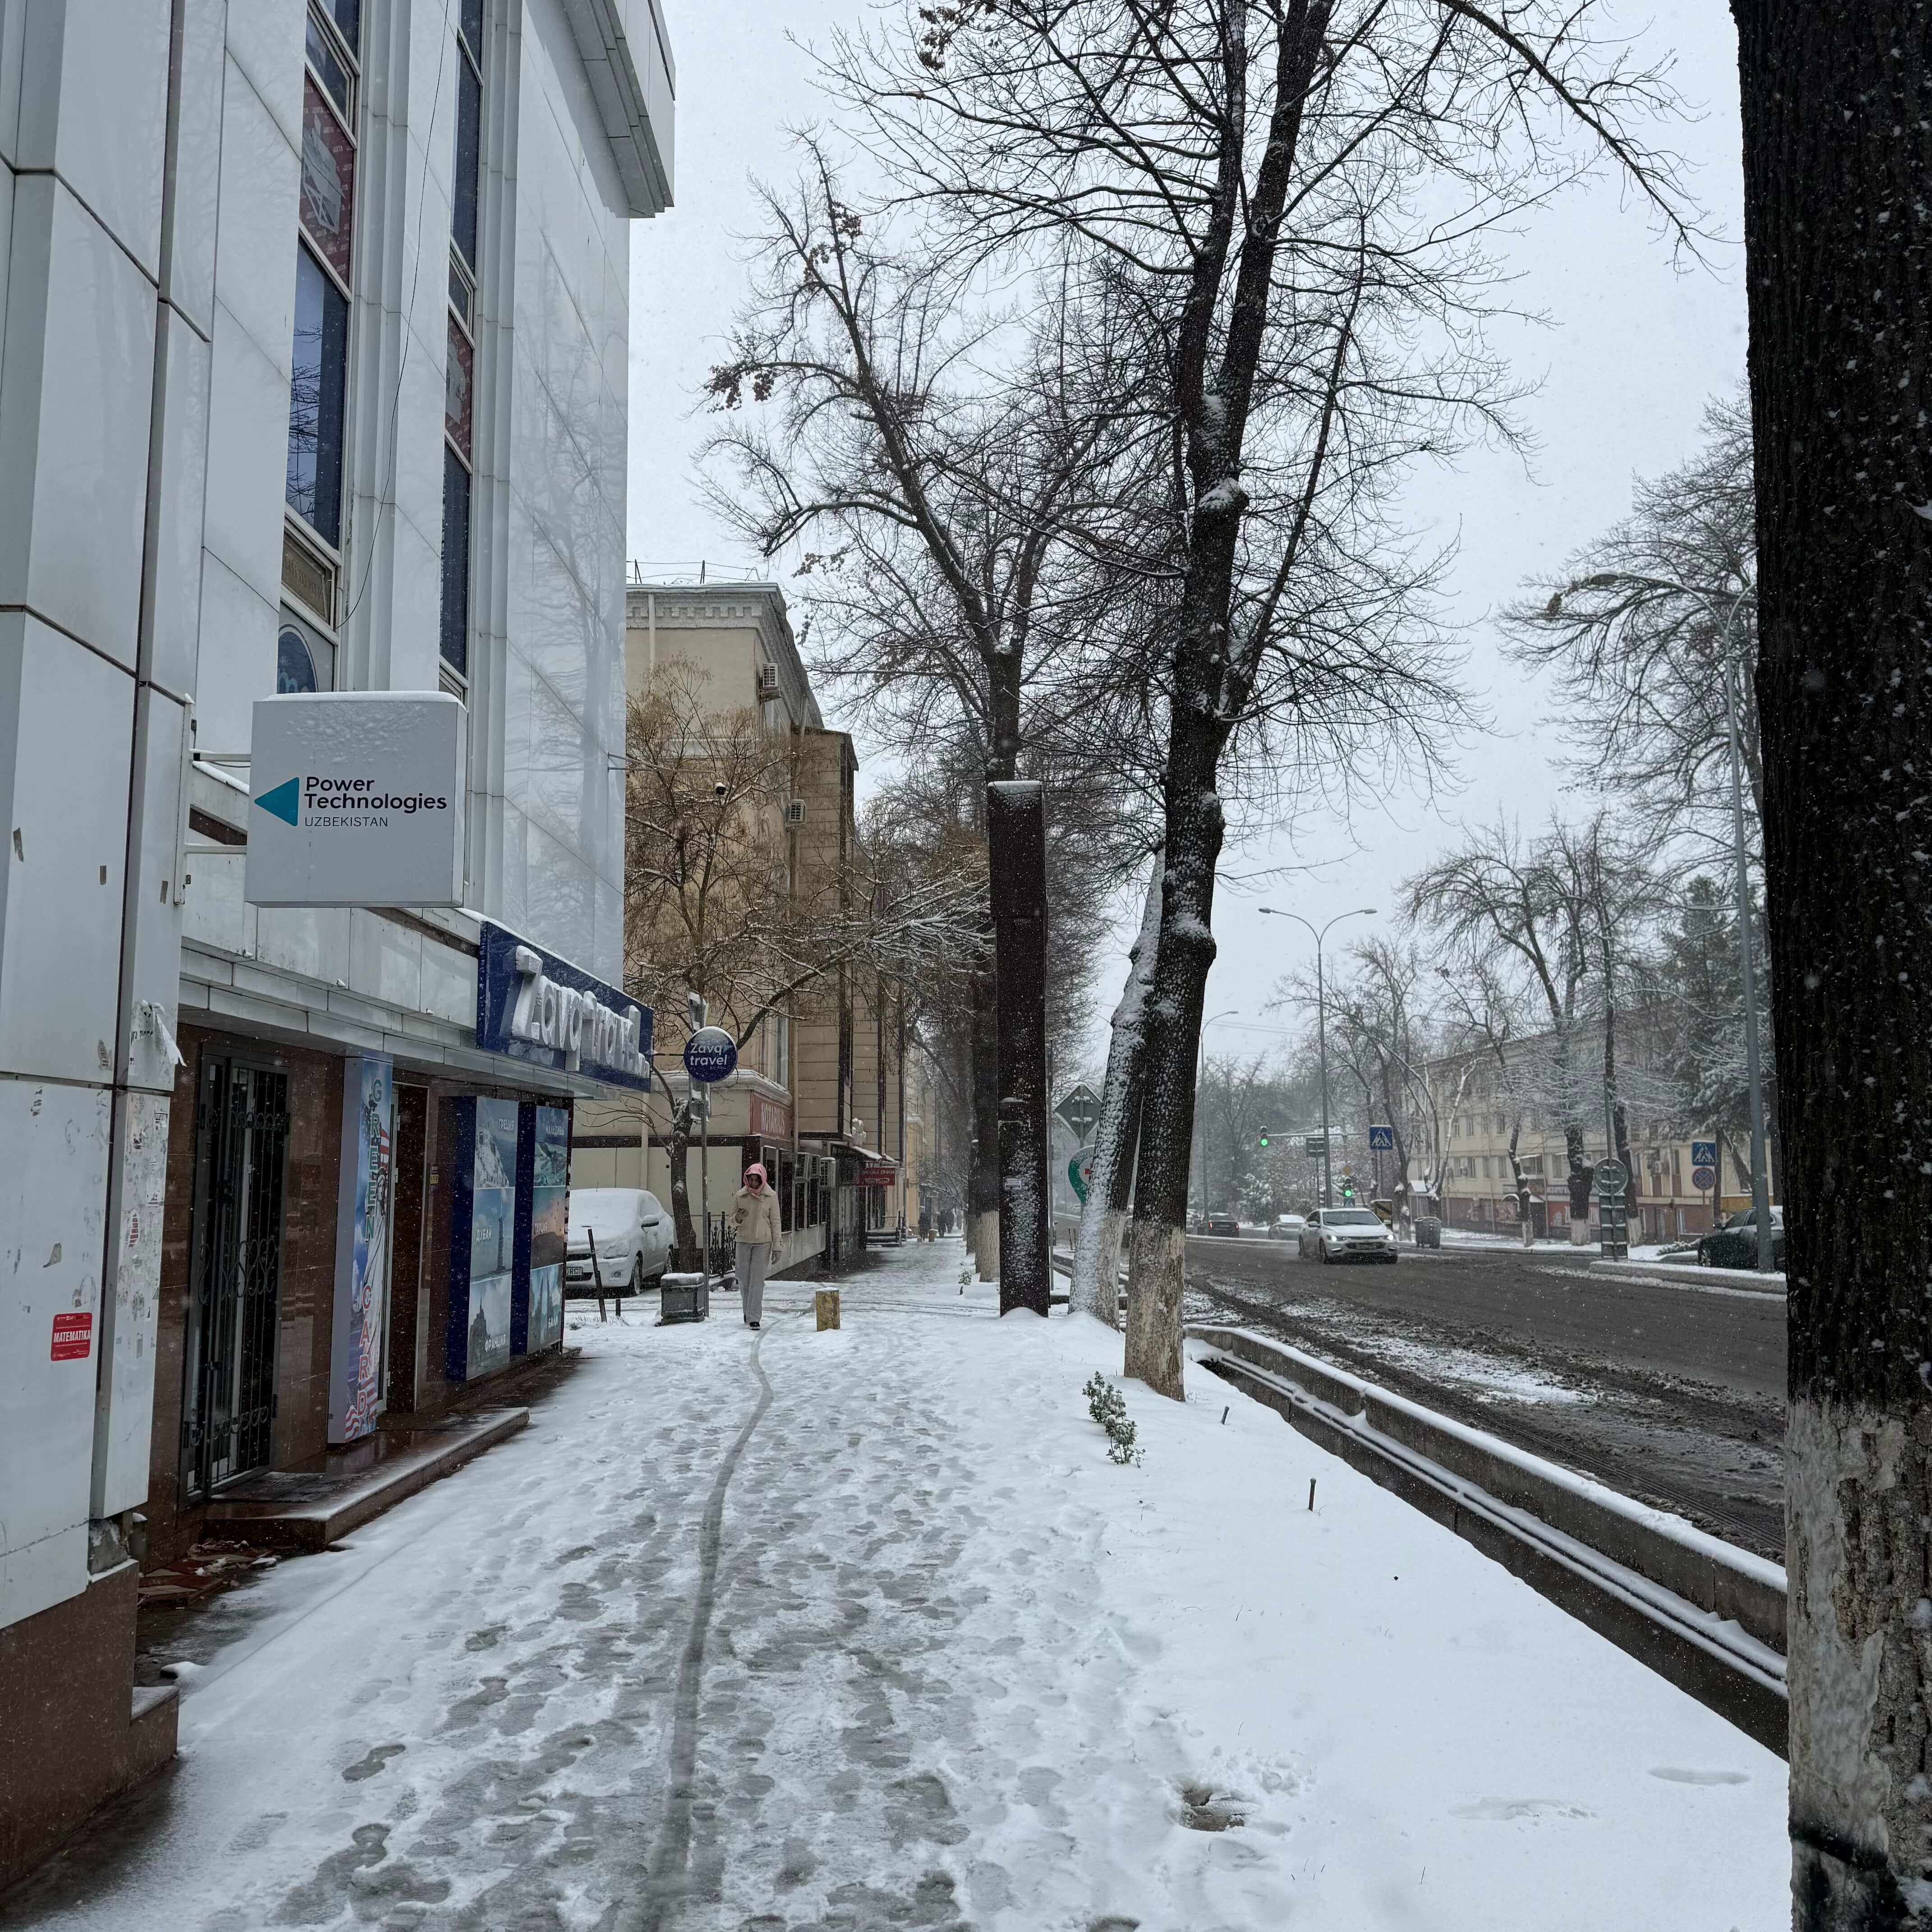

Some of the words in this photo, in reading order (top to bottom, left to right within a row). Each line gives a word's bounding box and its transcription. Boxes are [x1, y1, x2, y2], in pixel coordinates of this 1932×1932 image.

[306, 776, 375, 791] Power
[304, 793, 447, 814] Technologies
[304, 817, 388, 827] UZBEKISTAN
[511, 947, 581, 1072] Zavq
[690, 1043, 722, 1055] Zavq
[690, 1054, 727, 1066] travel
[498, 1118, 514, 1132] ГРЕЦИЯ
[761, 1101, 785, 1136] NOTARIUS
[545, 1124, 565, 1137] МАЛЬДИВЫ
[365, 1078, 382, 1241] GREEN
[476, 1225, 492, 1244] ДУБАЙ
[54, 1330, 91, 1343] MATEMATIKA
[485, 1334, 506, 1353] ФРАНЦИЯ
[357, 1285, 372, 1417] CARD
